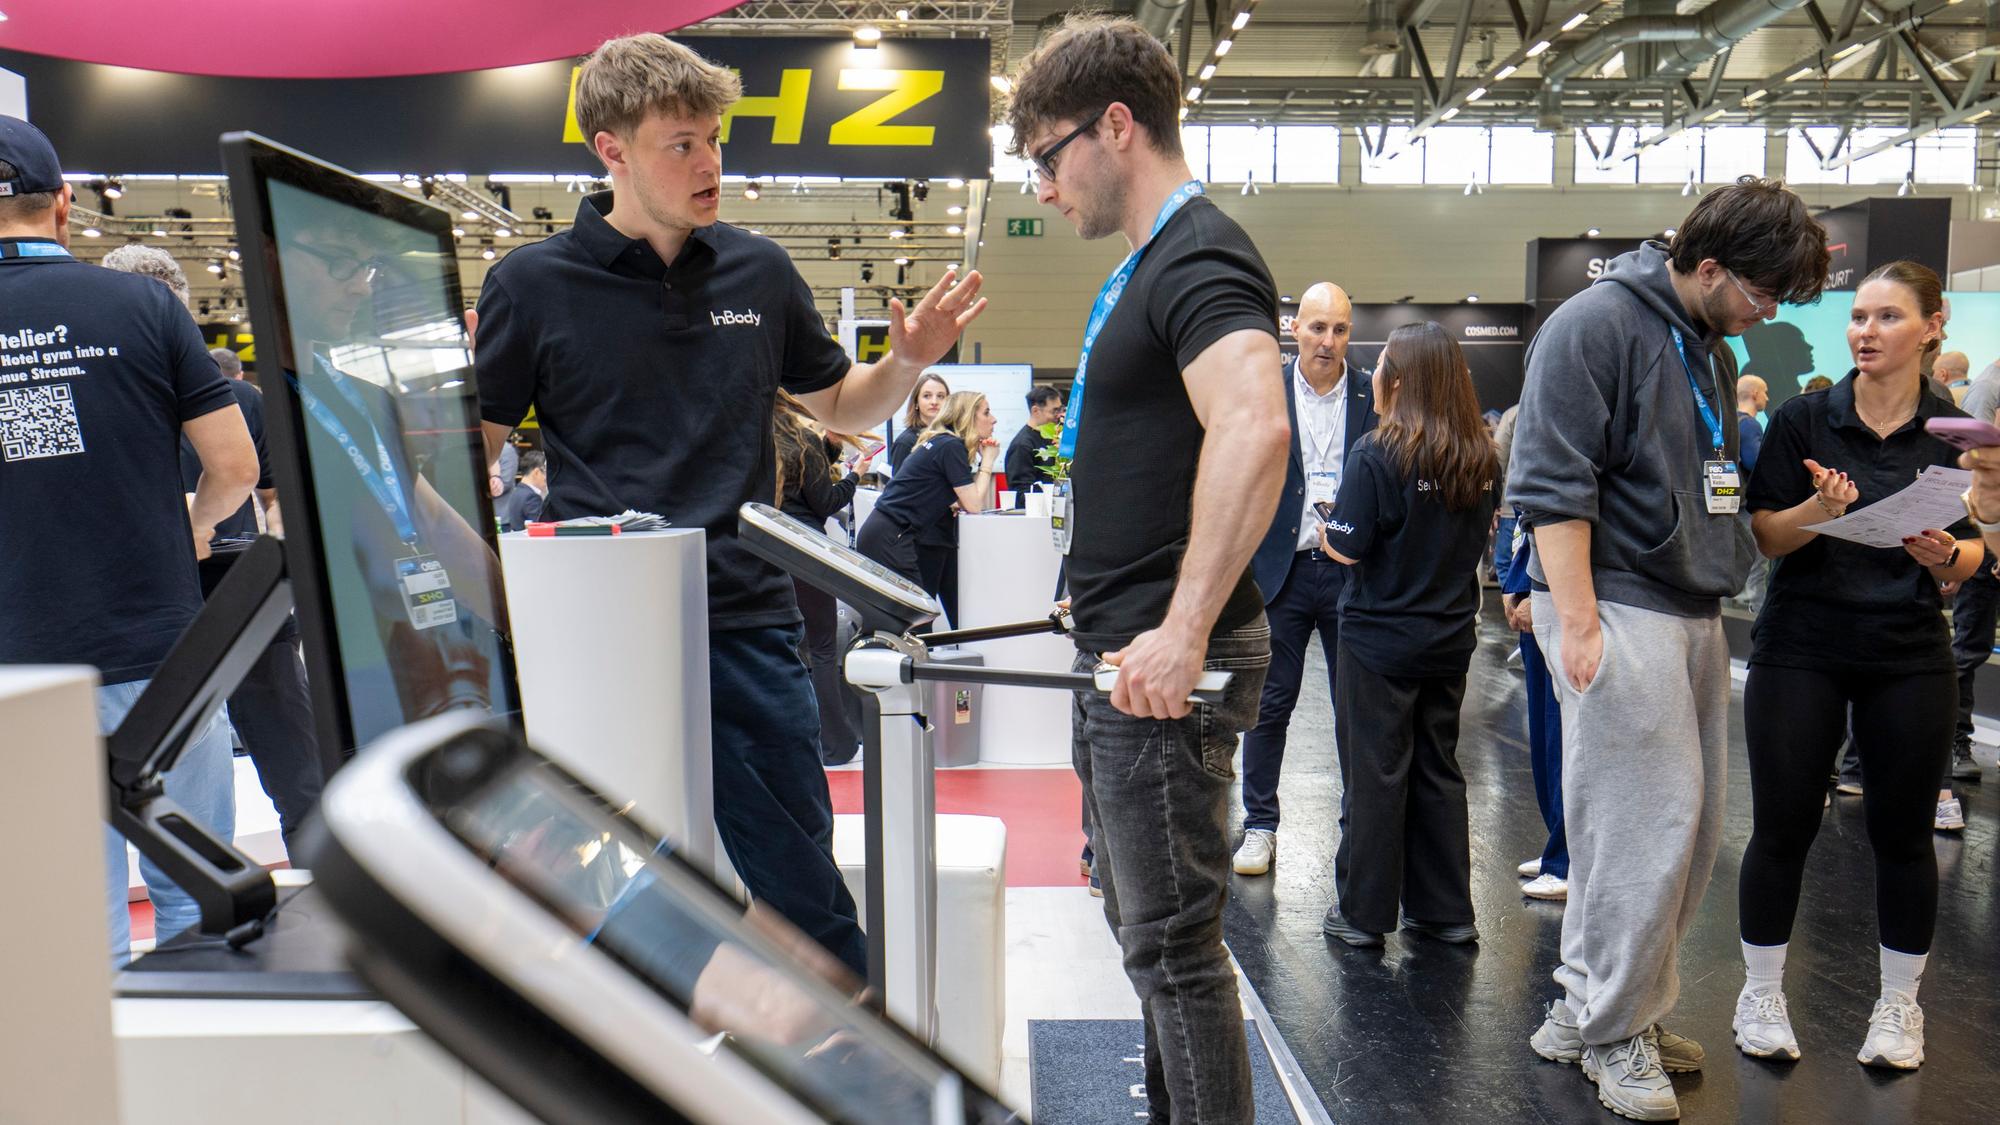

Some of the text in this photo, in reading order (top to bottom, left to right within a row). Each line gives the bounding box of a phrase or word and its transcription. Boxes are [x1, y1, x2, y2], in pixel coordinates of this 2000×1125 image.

[562, 66, 945, 146] HZ
[710, 308, 761, 326] InBody
[1464, 325, 1518, 337] COSMED.COM
[1, 345, 119, 367] Hotel gym into a
[31, 365, 87, 380] Stream.
[1716, 488, 1736, 496] DHZ
[1325, 520, 1354, 535] nBody
